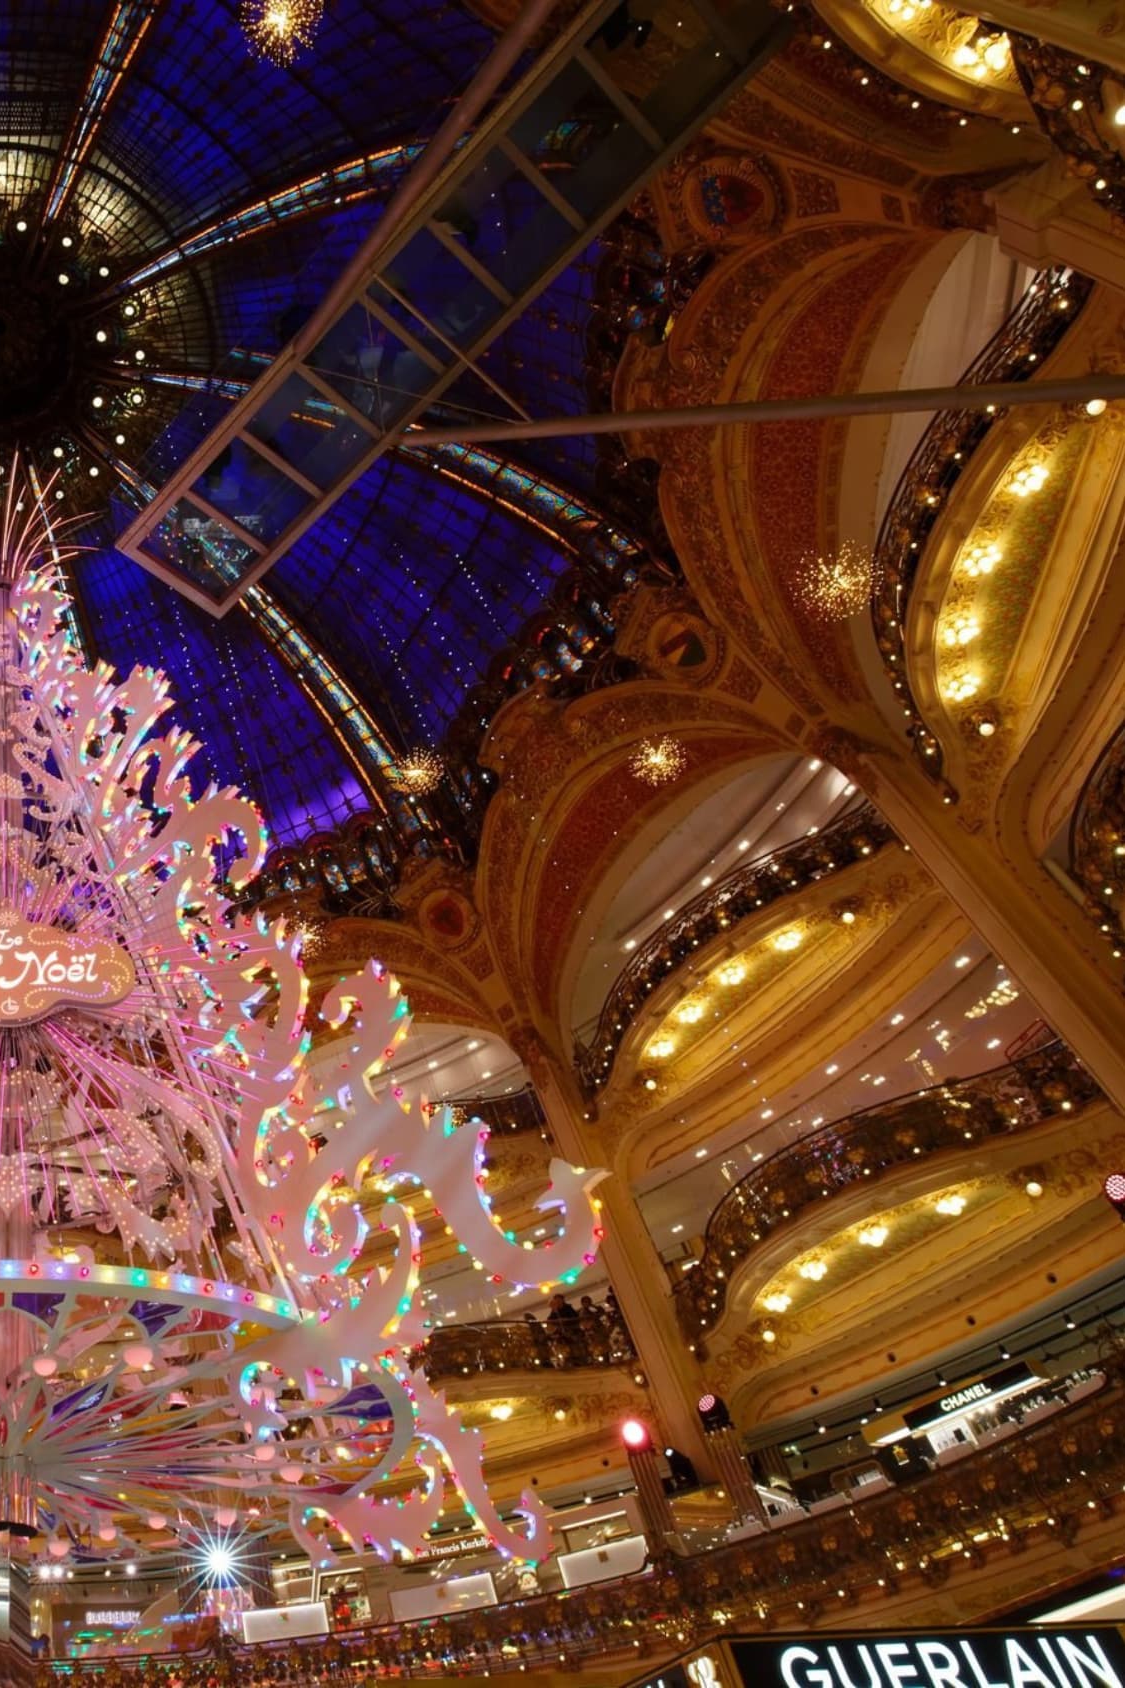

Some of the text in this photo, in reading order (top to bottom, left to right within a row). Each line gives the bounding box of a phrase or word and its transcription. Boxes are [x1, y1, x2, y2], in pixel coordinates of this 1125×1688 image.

[940, 1383, 993, 1412] CHANEL
[431, 1543, 460, 1556] Francis
[779, 1635, 1124, 1688] GUERLAIN
